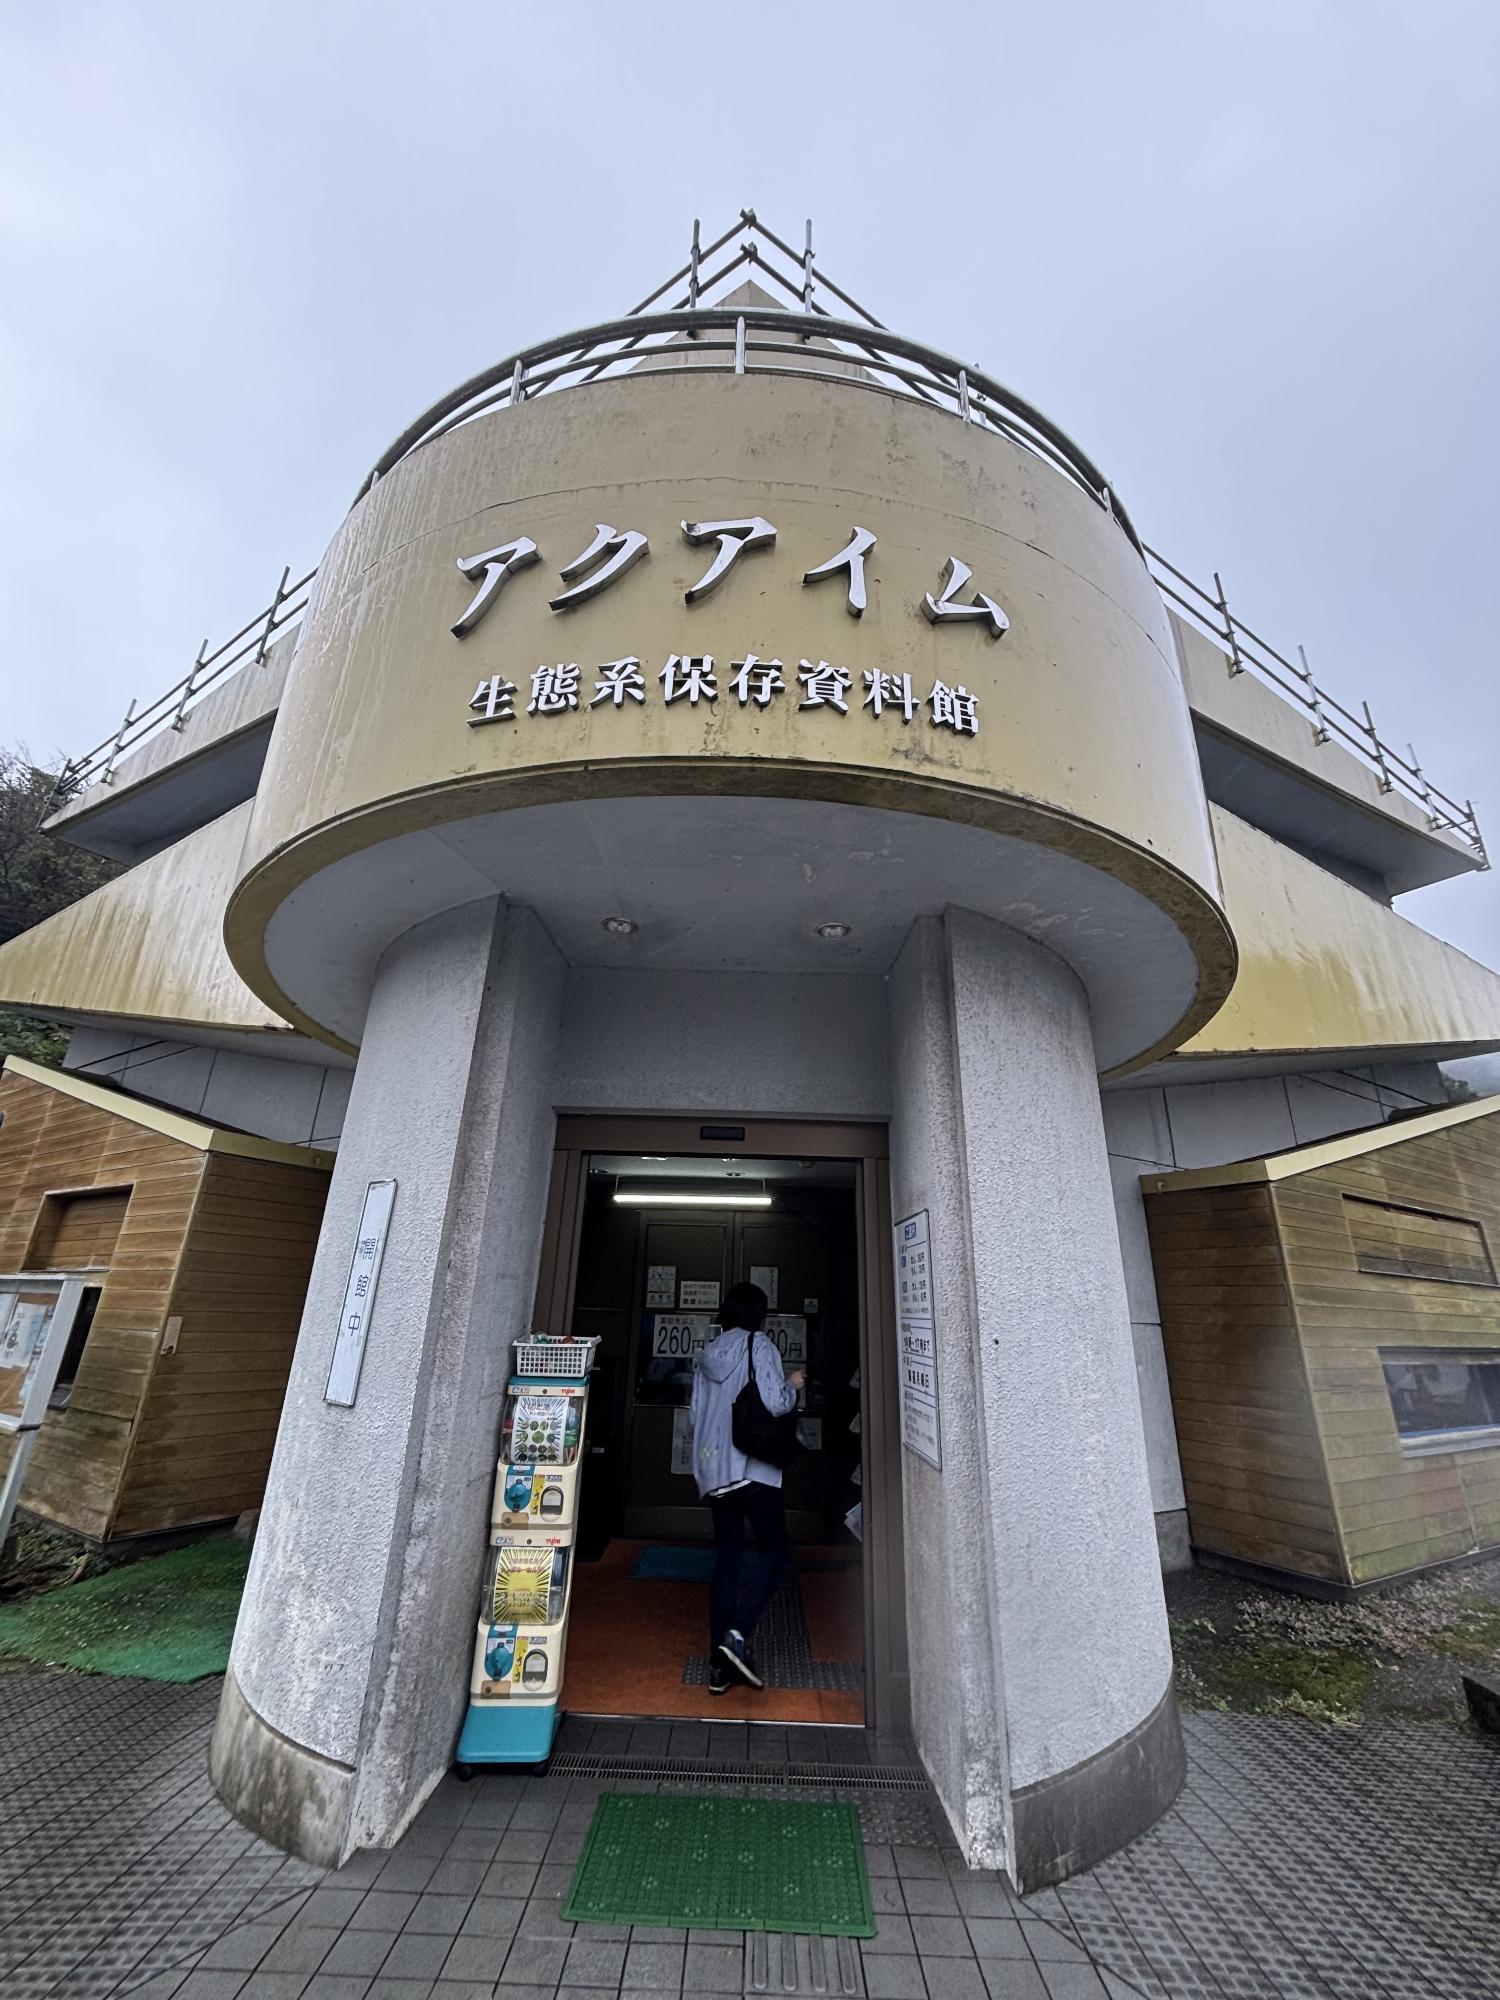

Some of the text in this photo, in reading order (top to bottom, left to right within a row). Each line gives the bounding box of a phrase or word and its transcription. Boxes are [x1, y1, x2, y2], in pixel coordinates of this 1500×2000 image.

[450, 516, 1011, 640] アクアイム
[466, 653, 980, 736] 生態系保存資料館
